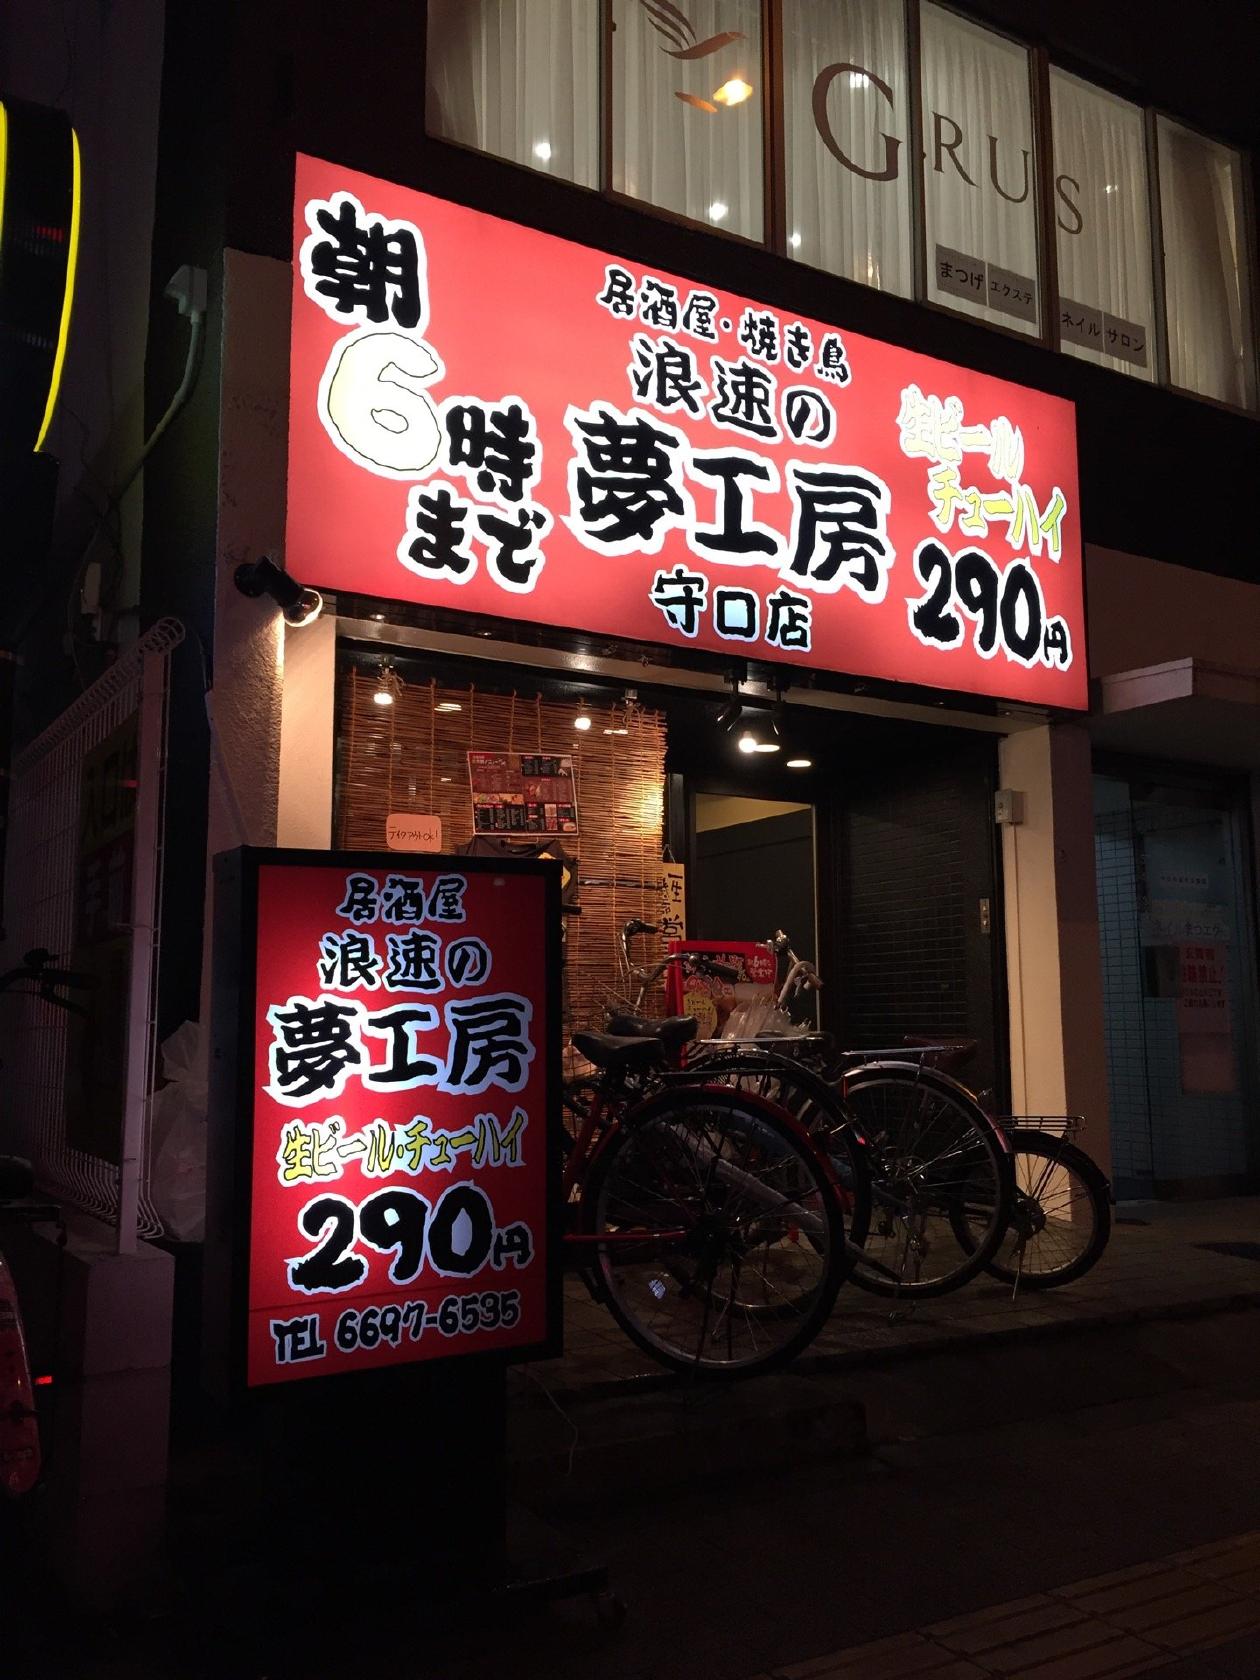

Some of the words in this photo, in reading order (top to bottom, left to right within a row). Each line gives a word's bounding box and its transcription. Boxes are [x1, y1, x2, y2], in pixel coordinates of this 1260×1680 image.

[812, 62, 1083, 235] GRUS
[309, 198, 423, 330] 朝
[939, 260, 985, 291] まつげ
[989, 279, 1034, 306] エクステ
[1060, 310, 1102, 338] ネイル
[1105, 328, 1145, 353] サロン
[633, 337, 832, 443] 浪速の
[900, 388, 1024, 478] 生ビール
[406, 487, 549, 585] まで
[572, 408, 889, 594] 夢工房
[931, 467, 1066, 556] チューハイ
[653, 567, 812, 649] 守口店
[911, 542, 1070, 667] 290円
[338, 876, 466, 923] 居酒屋
[320, 934, 489, 989] 浪速の
[273, 997, 531, 1097] 夢工房
[291, 1183, 532, 1292] 290円
[272, 1316, 327, 1363] TEL
